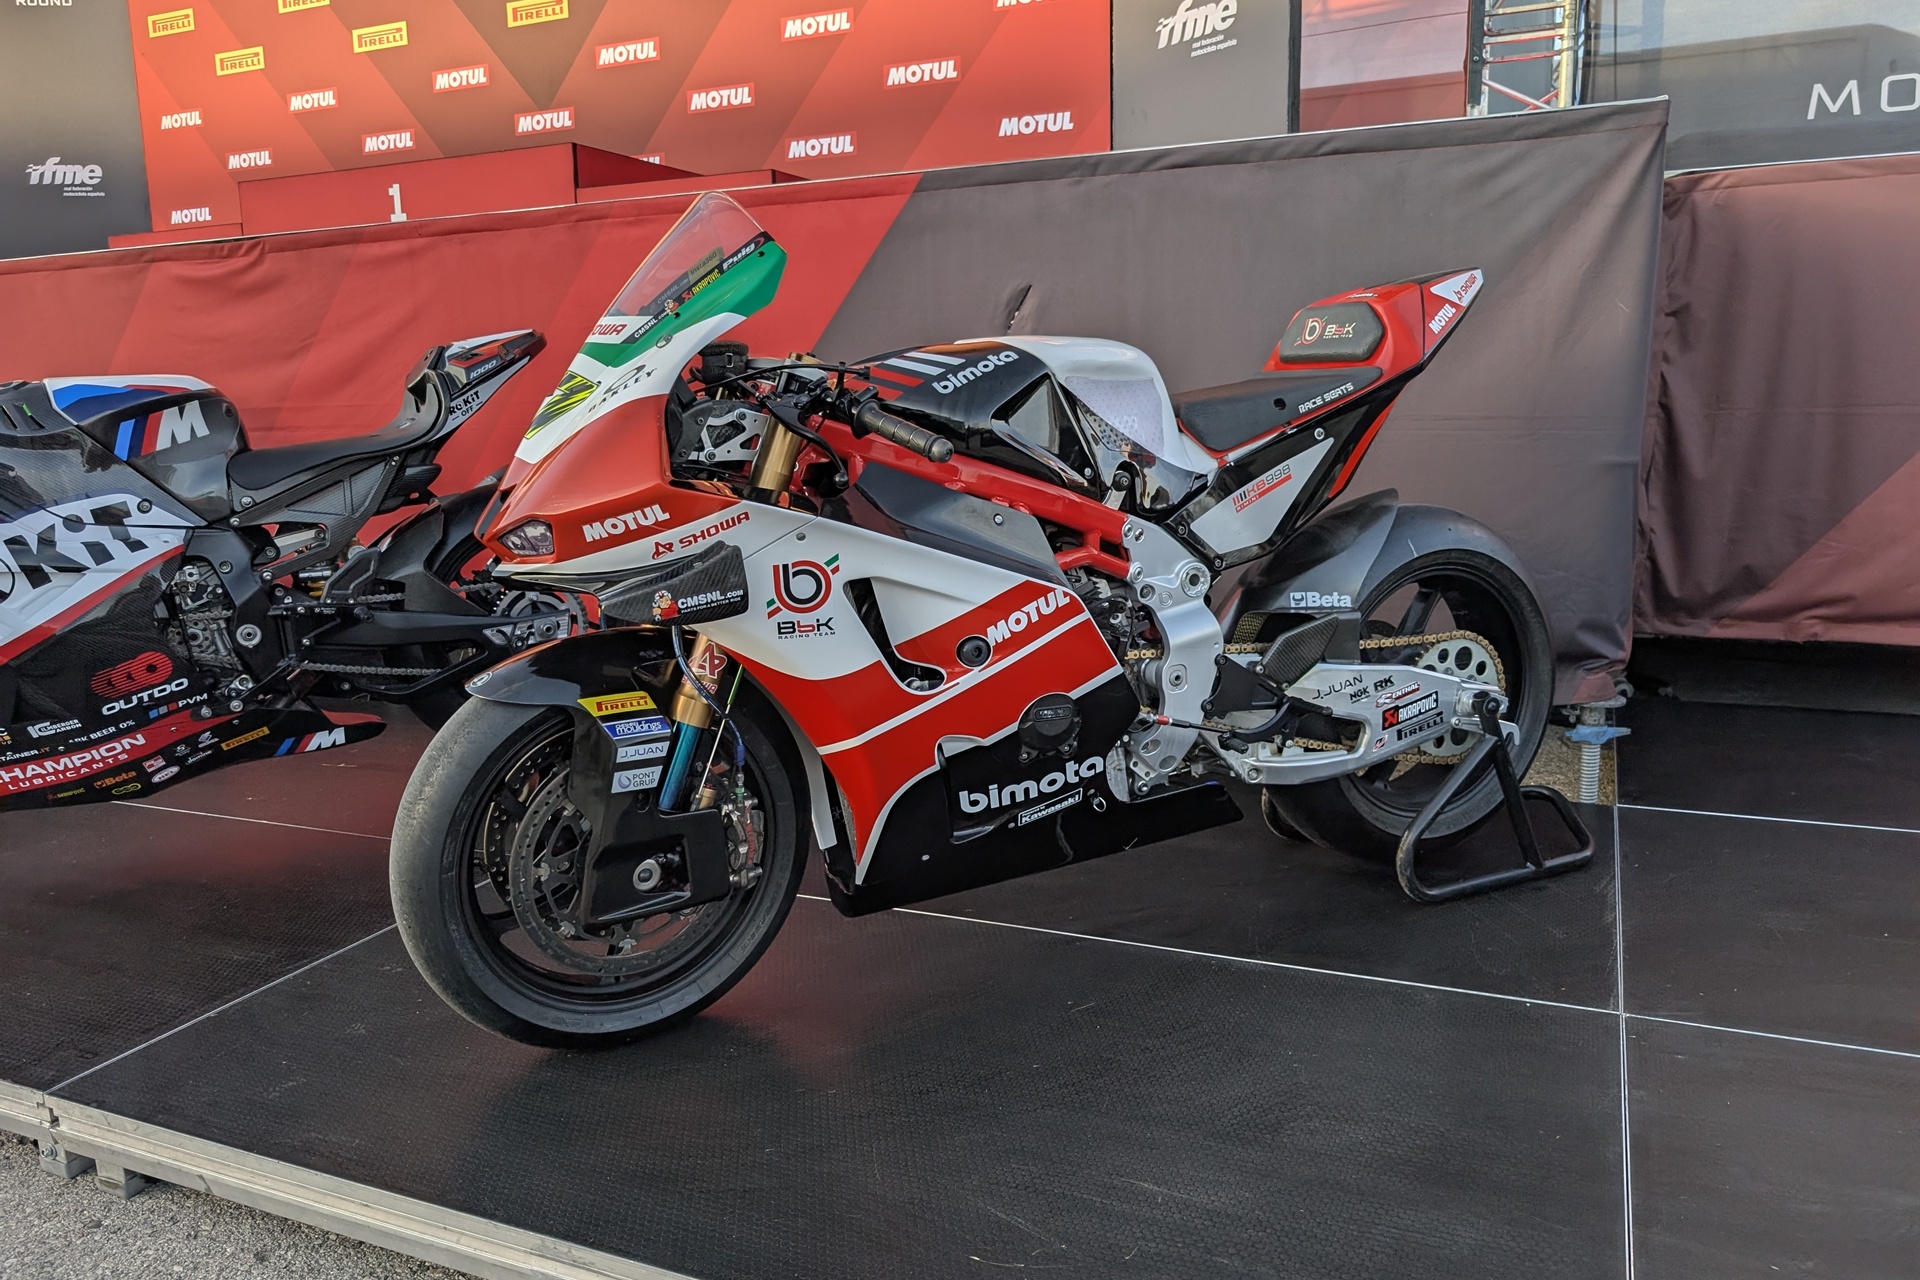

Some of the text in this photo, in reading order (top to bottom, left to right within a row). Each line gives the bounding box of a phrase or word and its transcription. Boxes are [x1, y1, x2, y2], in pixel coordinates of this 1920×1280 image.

[512, 0, 564, 22] PIRELLI
[152, 14, 191, 33] PIRELLI
[784, 11, 851, 39] MOTUL
[357, 27, 403, 48] PIRELLI
[219, 52, 260, 71] PIRELLI
[599, 41, 657, 65] MOTUL
[435, 68, 487, 90] MOTUL
[886, 59, 958, 86] MOTUL
[289, 91, 336, 111] MOTUL
[690, 87, 752, 110] MOTUL
[161, 111, 202, 129] MOTUL
[517, 111, 572, 133] MOTUL
[998, 111, 1074, 137] MOTUL
[364, 132, 413, 152] MOTUL
[788, 135, 854, 159] MOTUL
[228, 151, 272, 169] MOTUL
[388, 183, 407, 222] 1
[171, 207, 212, 225] MOTUL
[723, 243, 755, 269] Puig
[1428, 303, 1456, 334] MOTUL
[592, 324, 628, 336] OWA
[469, 360, 497, 379] 1000
[932, 350, 1020, 394] bimota
[1298, 382, 1354, 414] RACE SEATS
[461, 405, 474, 416] OFF
[582, 504, 670, 543] MOTUL
[678, 511, 750, 549] SHOWA
[0, 501, 149, 592] KiT
[1306, 591, 1352, 607] Beta
[986, 588, 1070, 646] MOTUL
[1312, 674, 1363, 700] J.JUAN
[1350, 686, 1370, 701] NGK
[1373, 675, 1395, 691] RK
[101, 678, 189, 715] OUTDO
[178, 693, 208, 708] PVM
[596, 696, 648, 712] PIRELLI
[90, 726, 117, 740] BEER
[119, 720, 136, 729] 0%
[1396, 711, 1444, 741] PIRELLI
[0, 733, 146, 783] HAMPION
[620, 745, 664, 759] J.JUAN
[8, 753, 129, 790] LUBRICANTS
[104, 770, 137, 786] Beta
[632, 771, 655, 780] PONT
[632, 778, 656, 787] GRUP
[959, 756, 1104, 813] bimota
[1021, 795, 1079, 824] Kawasaki
